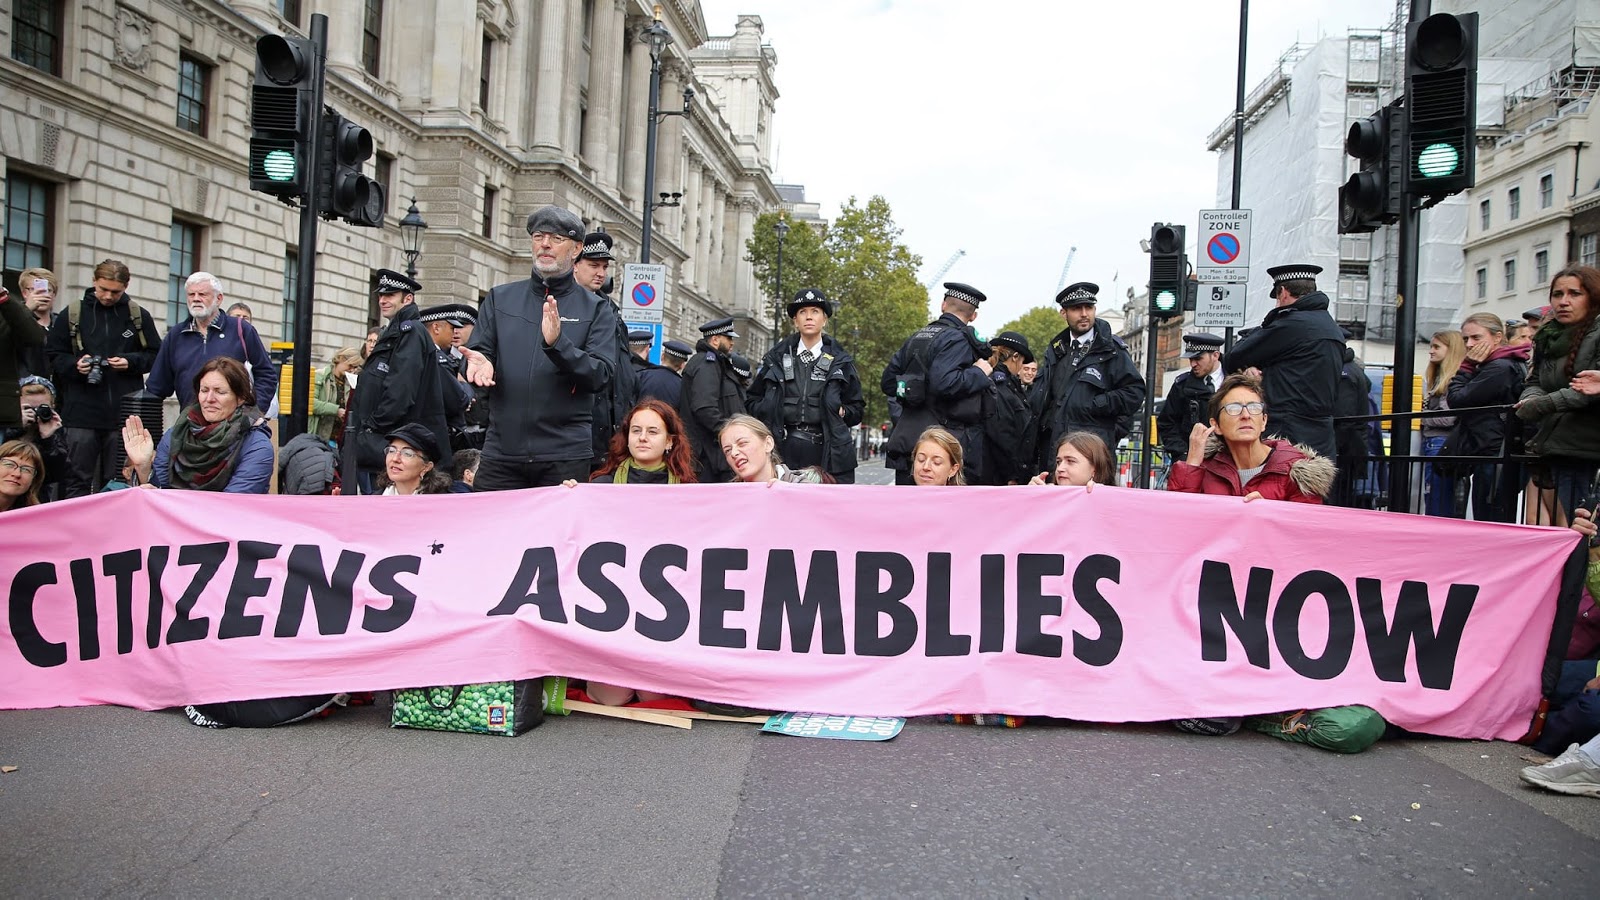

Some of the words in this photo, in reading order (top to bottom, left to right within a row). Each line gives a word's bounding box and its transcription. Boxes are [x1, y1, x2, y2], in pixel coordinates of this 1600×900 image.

[1209, 222, 1240, 230] ZONE
[9, 541, 421, 667] CITIZENS
[487, 542, 1123, 666] ASSEMBLIES
[1198, 560, 1479, 690] NOW
